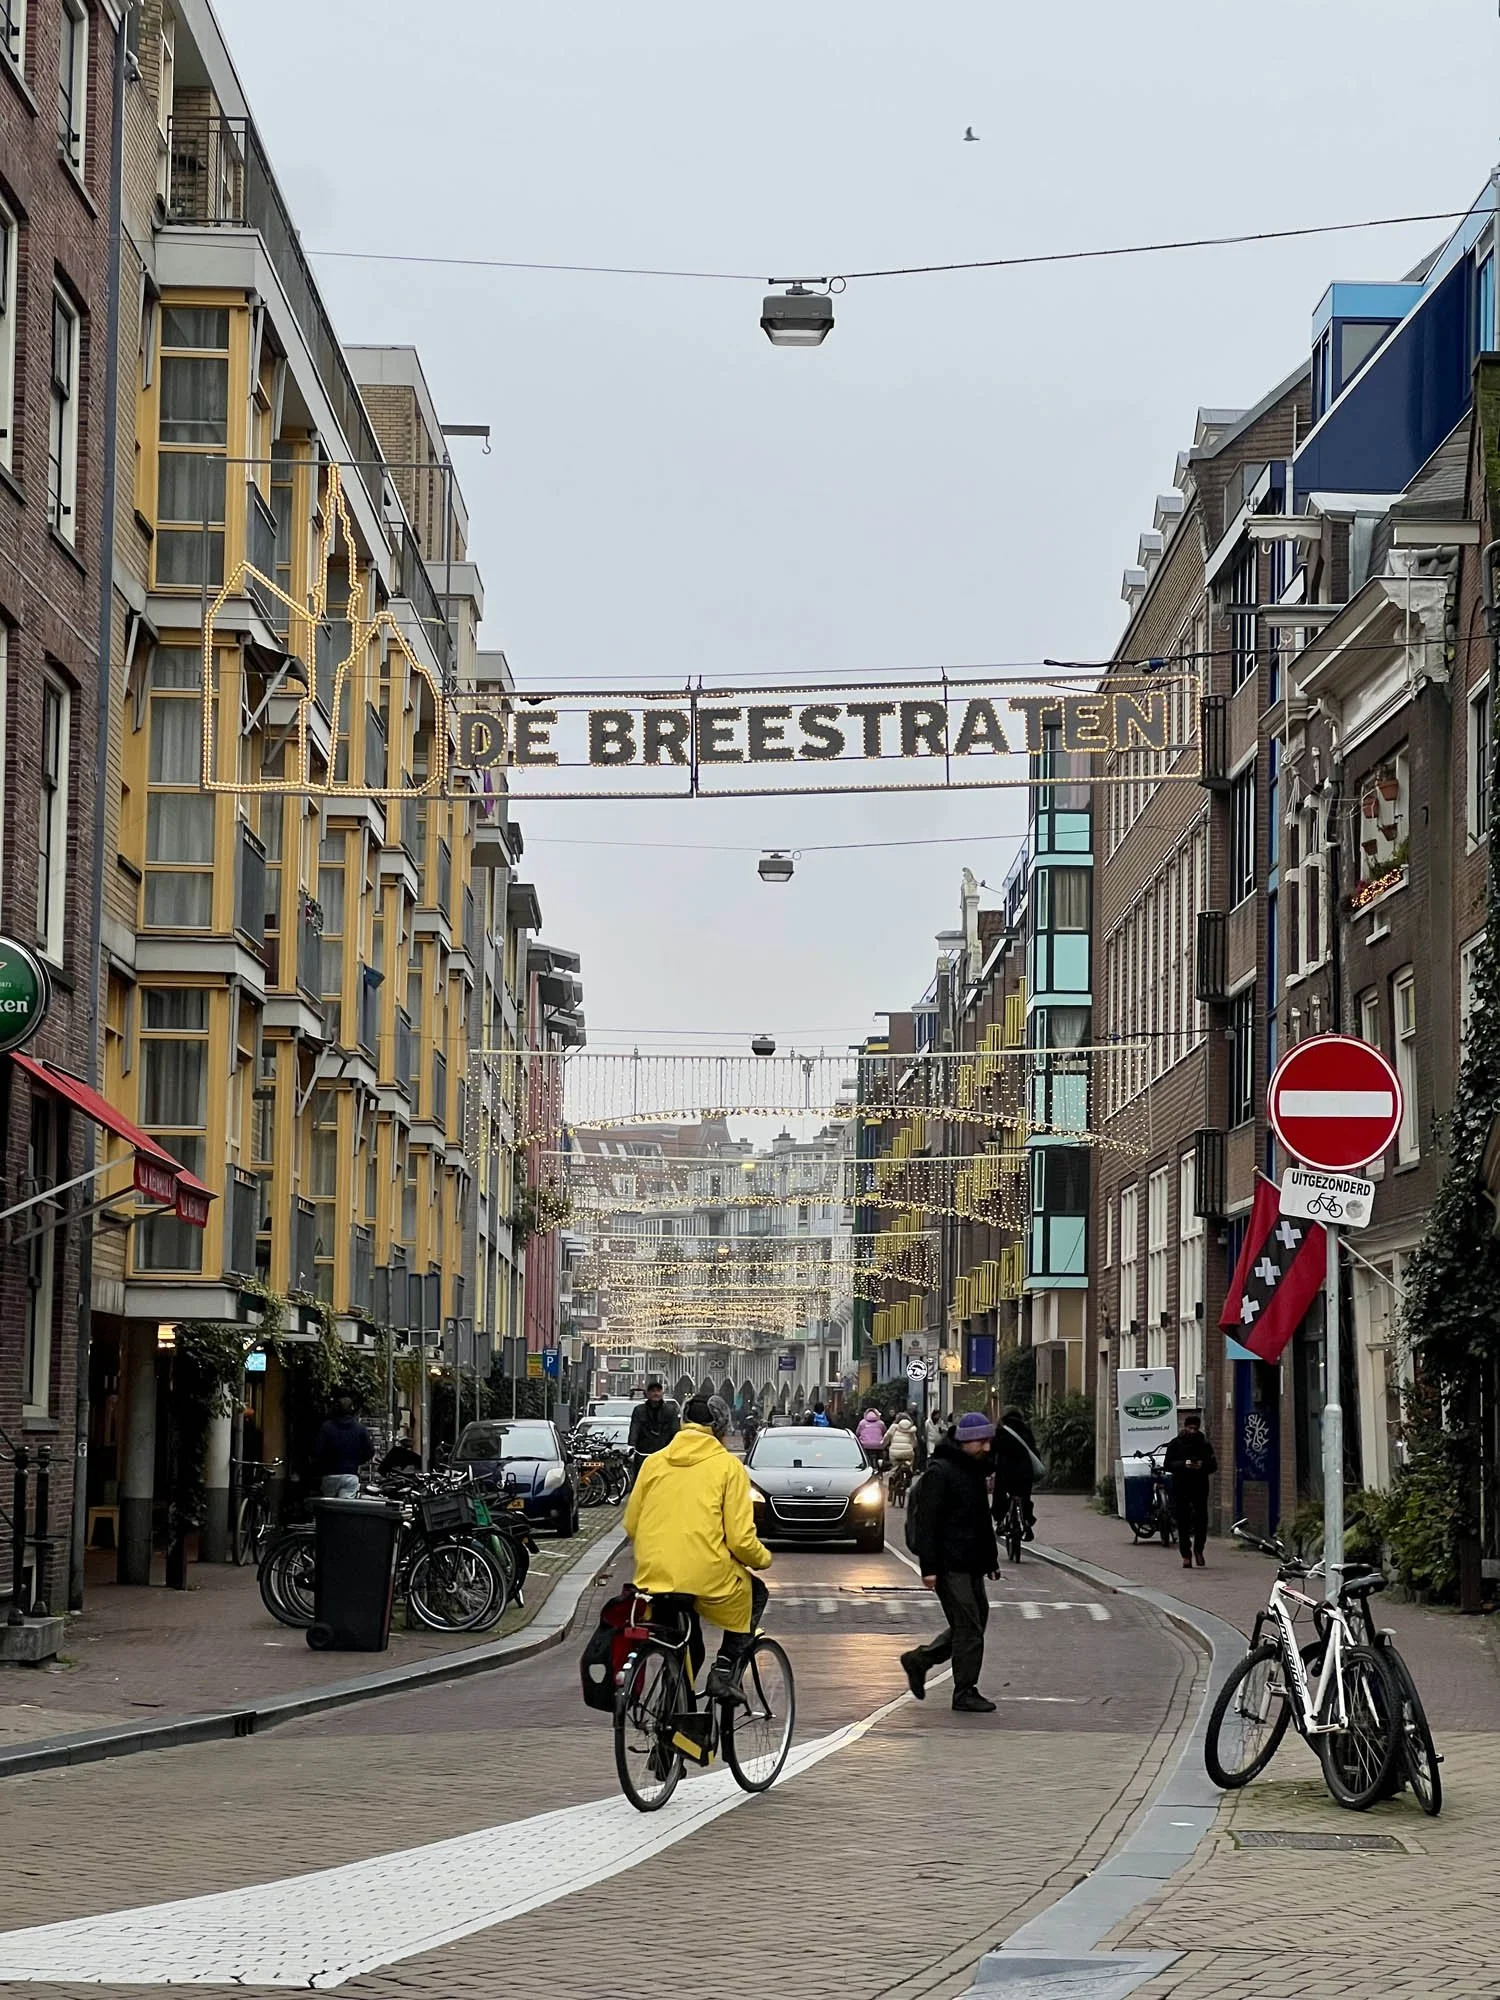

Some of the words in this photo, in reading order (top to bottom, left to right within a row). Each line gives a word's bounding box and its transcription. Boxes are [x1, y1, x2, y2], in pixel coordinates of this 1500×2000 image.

[456, 709, 559, 769] DE
[588, 692, 1169, 767] BREESTRATEN
[1291, 1171, 1371, 1197] UITGEZONDERD
[547, 1356, 554, 1367] P
